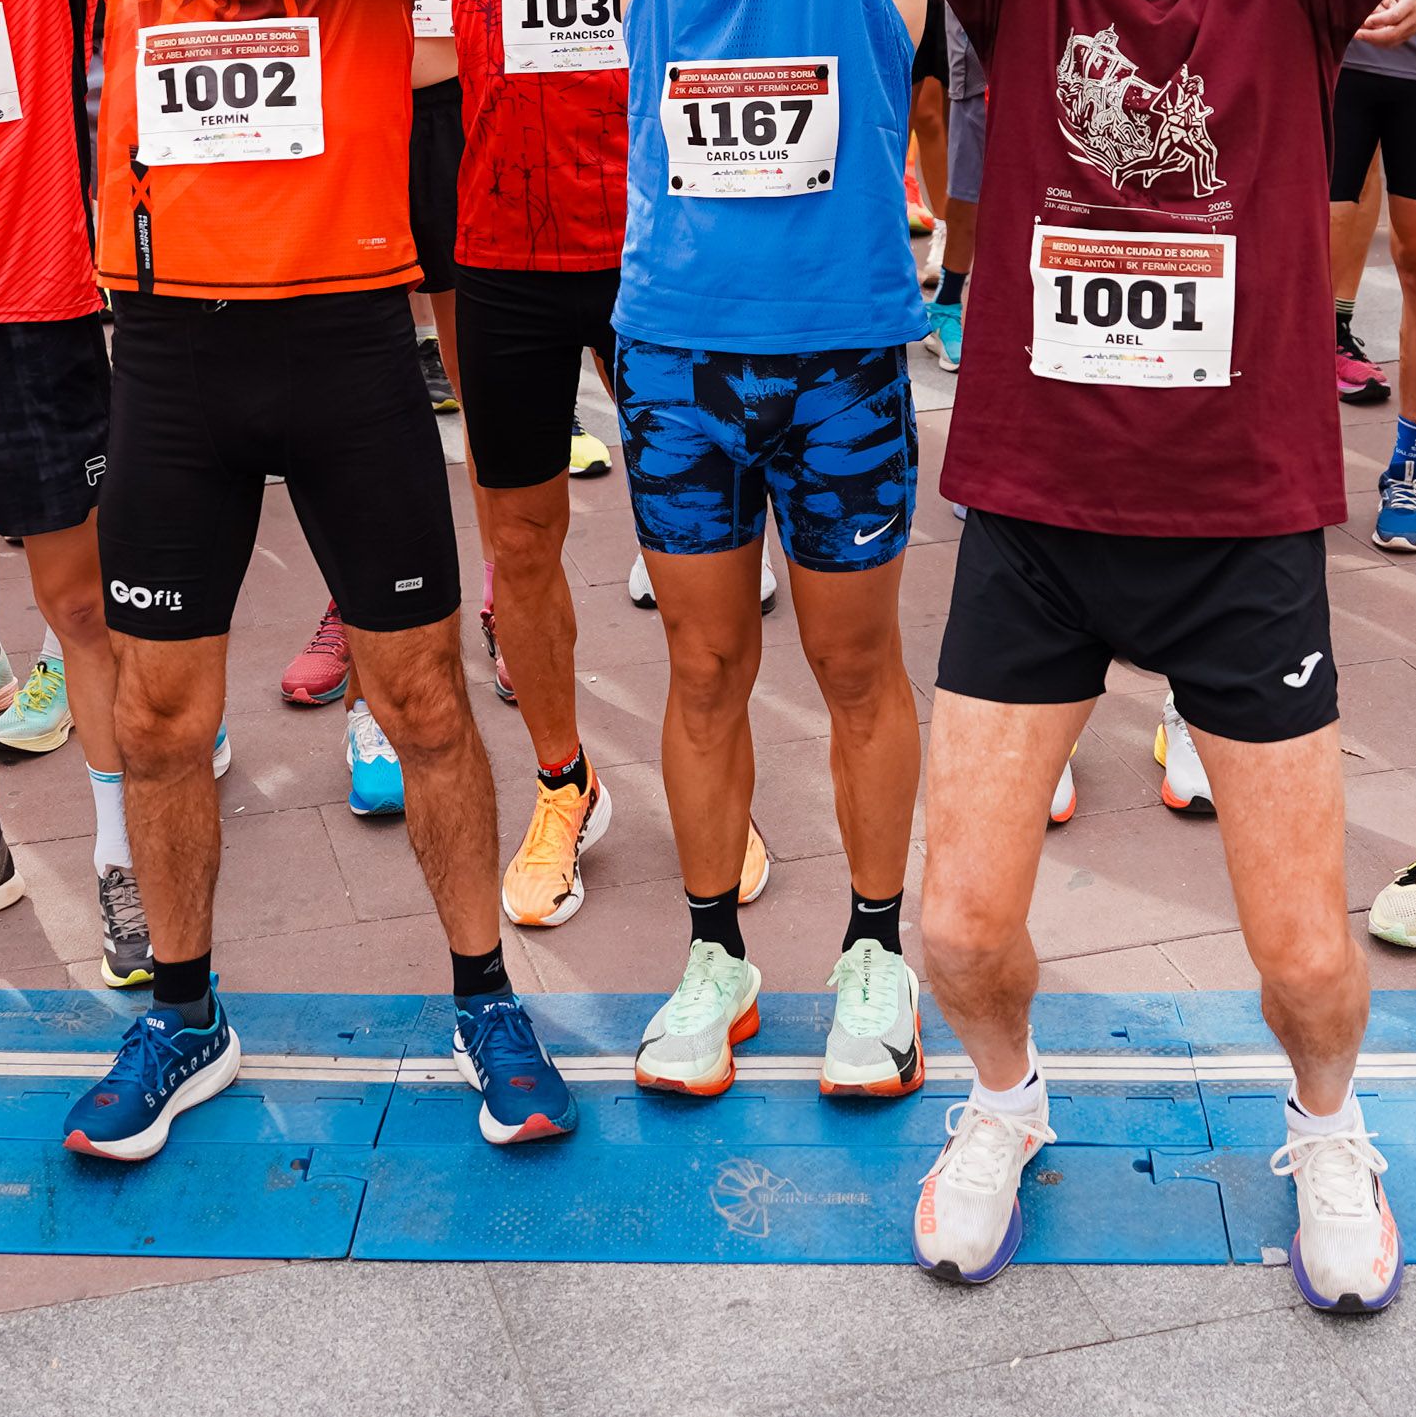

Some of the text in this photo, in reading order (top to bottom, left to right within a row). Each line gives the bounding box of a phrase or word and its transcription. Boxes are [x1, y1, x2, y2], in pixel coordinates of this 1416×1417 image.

[154, 32, 296, 47] MEDIO MARATÓN CIUDAD DE SORIA
[550, 30, 615, 41] FRANCISCO
[166, 44, 299, 59] ABEL ANTÓN 5K FERMÍN CACHO
[680, 74, 699, 82] MEDIO
[701, 72, 742, 81] MARATÓN
[743, 72, 775, 80] CIUDAD
[791, 70, 816, 78] SORIA
[158, 62, 297, 113] 1002
[689, 86, 706, 94] ABEL
[706, 84, 734, 93] ANTÓN
[759, 82, 789, 92] FERMÍN
[791, 83, 819, 91] CACHO
[201, 112, 249, 126] FERMÍN
[683, 100, 812, 146] 1167
[706, 150, 789, 161] CARLOS LUIS
[1046, 187, 1232, 212] SORIA 2025
[1052, 242, 1210, 258] MEDIO MARATÓN CIUDAD DE SORIA
[1049, 256, 1211, 272] 21K ABEL ANTÓN 5K FERMÍN CACHO
[1054, 275, 1203, 331] 1001
[1105, 334, 1143, 346] ABEL
